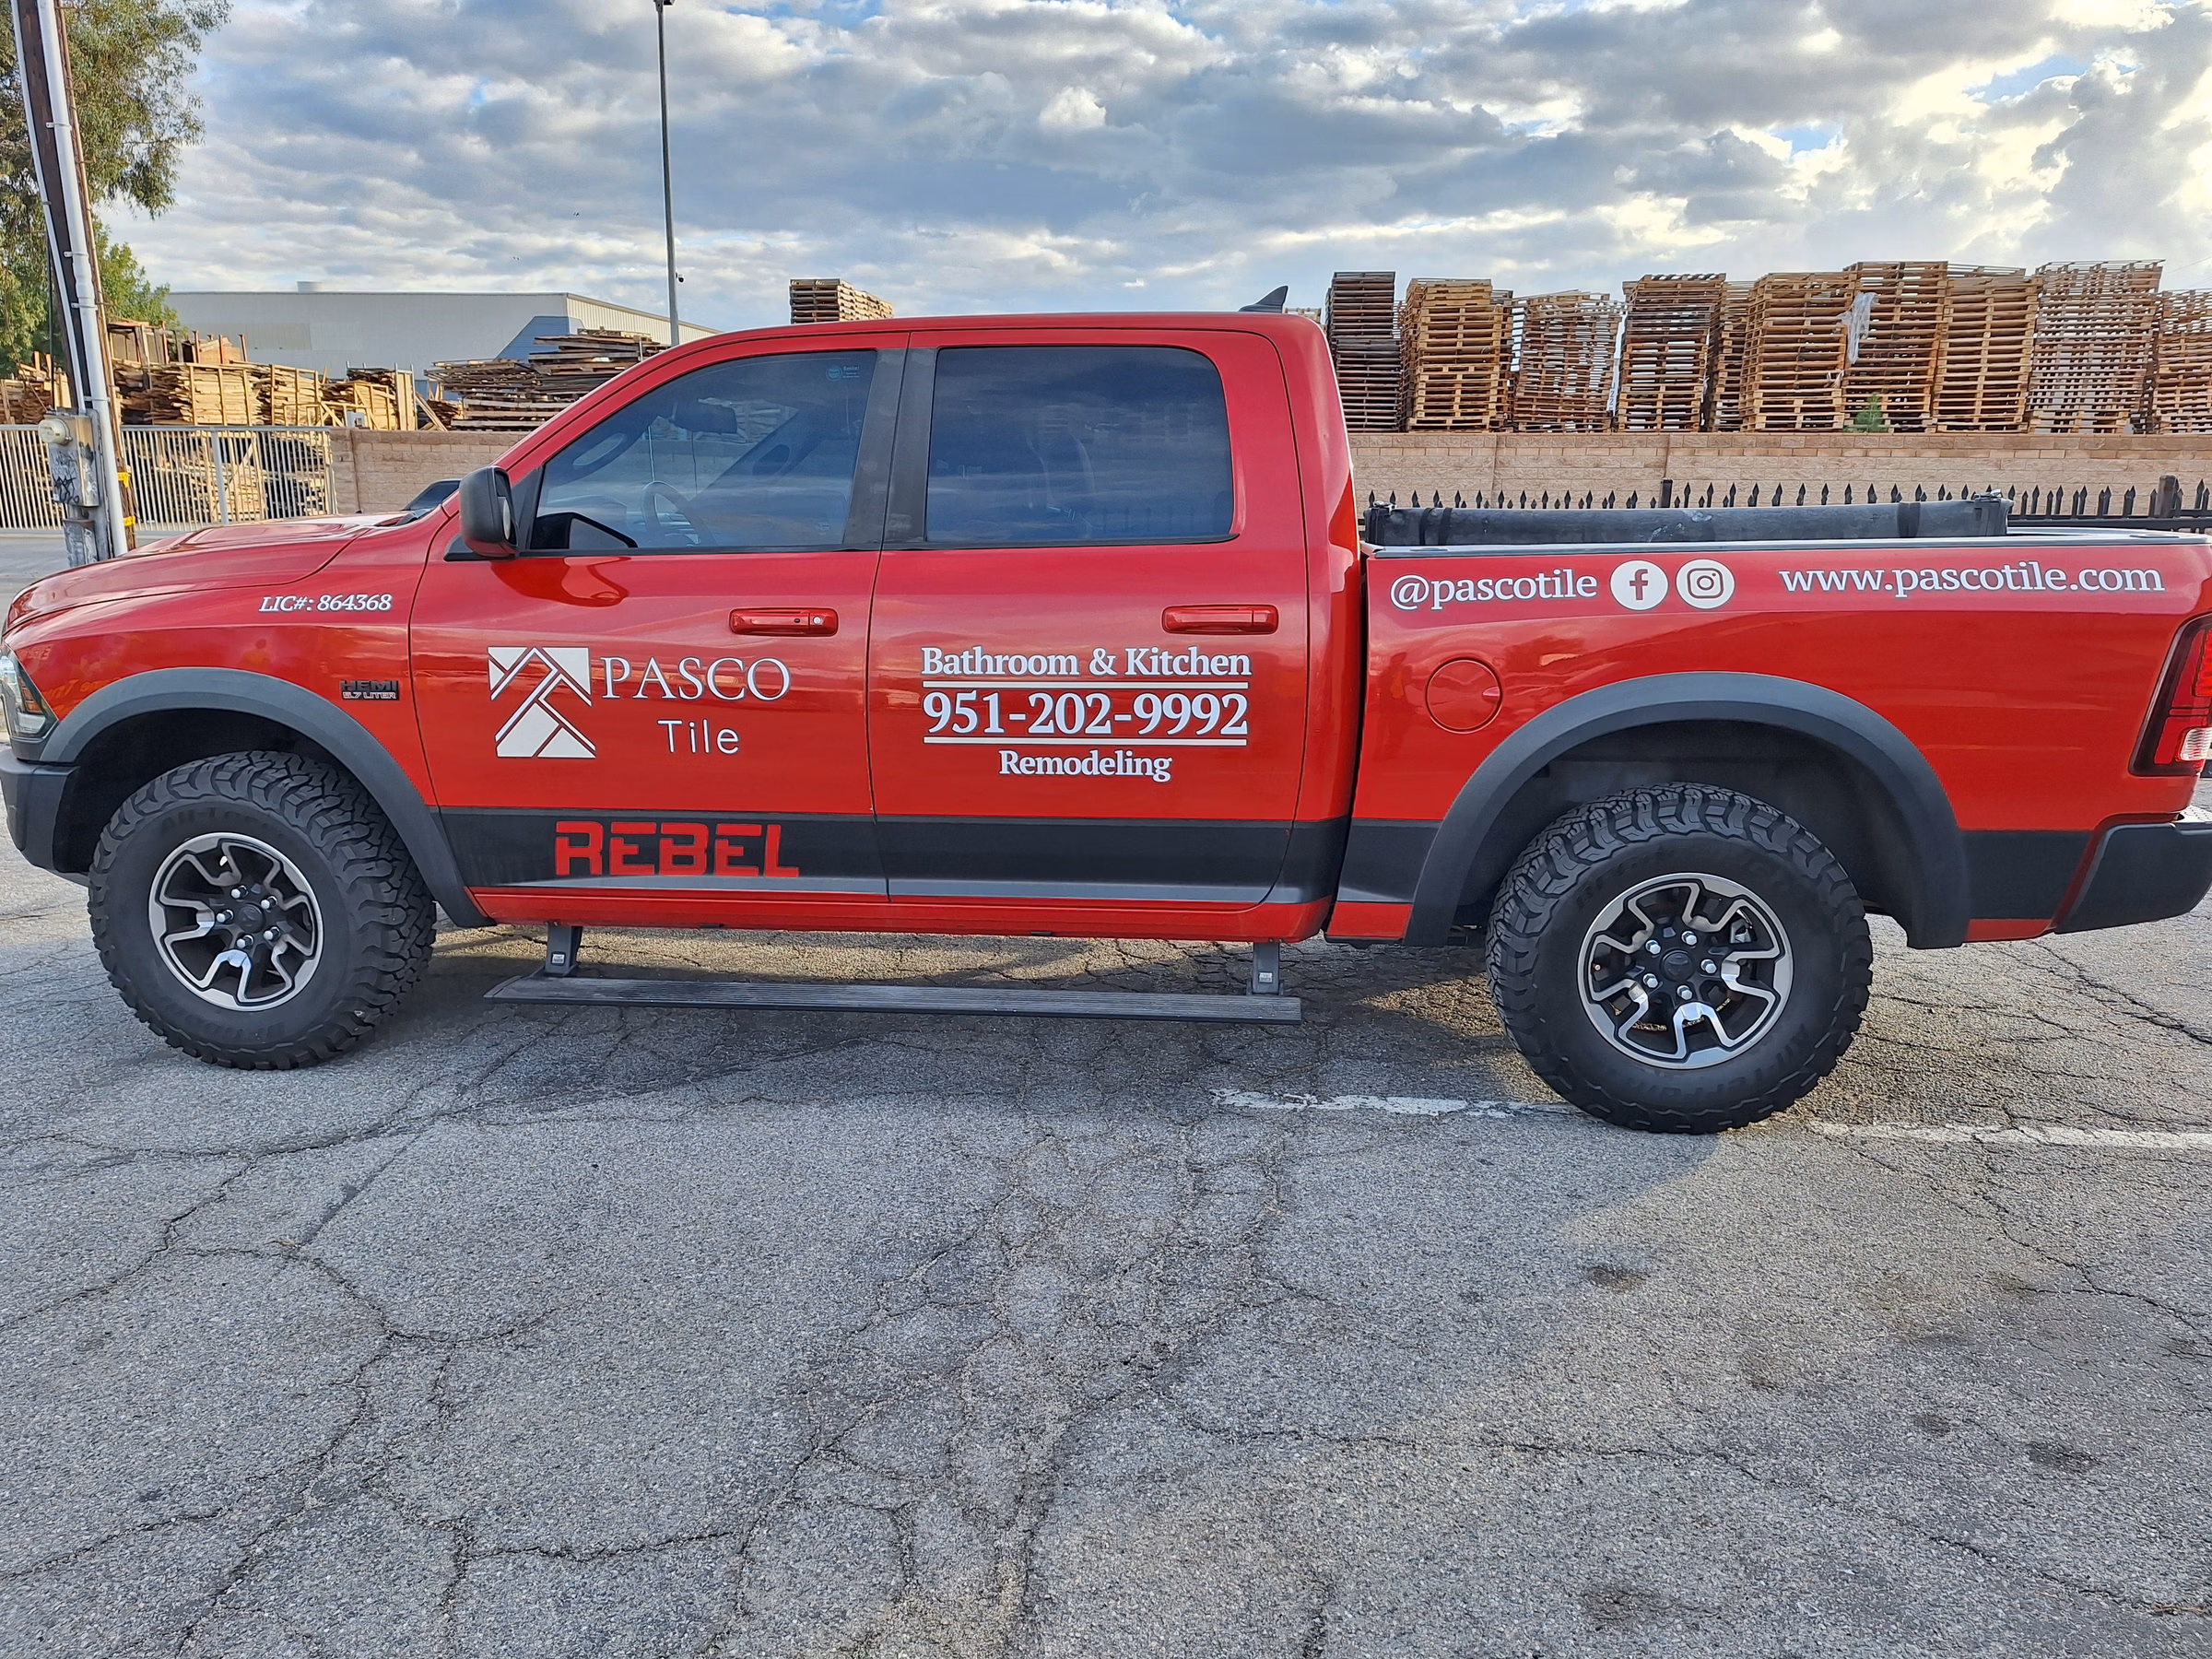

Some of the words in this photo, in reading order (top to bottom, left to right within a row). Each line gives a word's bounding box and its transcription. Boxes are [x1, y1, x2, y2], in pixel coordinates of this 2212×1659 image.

[1390, 568, 1597, 610] @pascotile
[1779, 561, 2166, 598] www.pascotile.com
[258, 596, 314, 612] LIC#:
[317, 594, 393, 611] 864368
[600, 656, 791, 700] PASCO
[921, 646, 1079, 676] Bathroom
[1088, 647, 1117, 676] &
[1125, 646, 1252, 676] Kitchen
[340, 680, 398, 691] HEMI
[363, 691, 396, 700] LITER
[923, 690, 1249, 735] 951-202-9992
[657, 719, 739, 754] Tile
[998, 749, 1172, 782] Remodeling
[555, 821, 800, 877] REBEL
